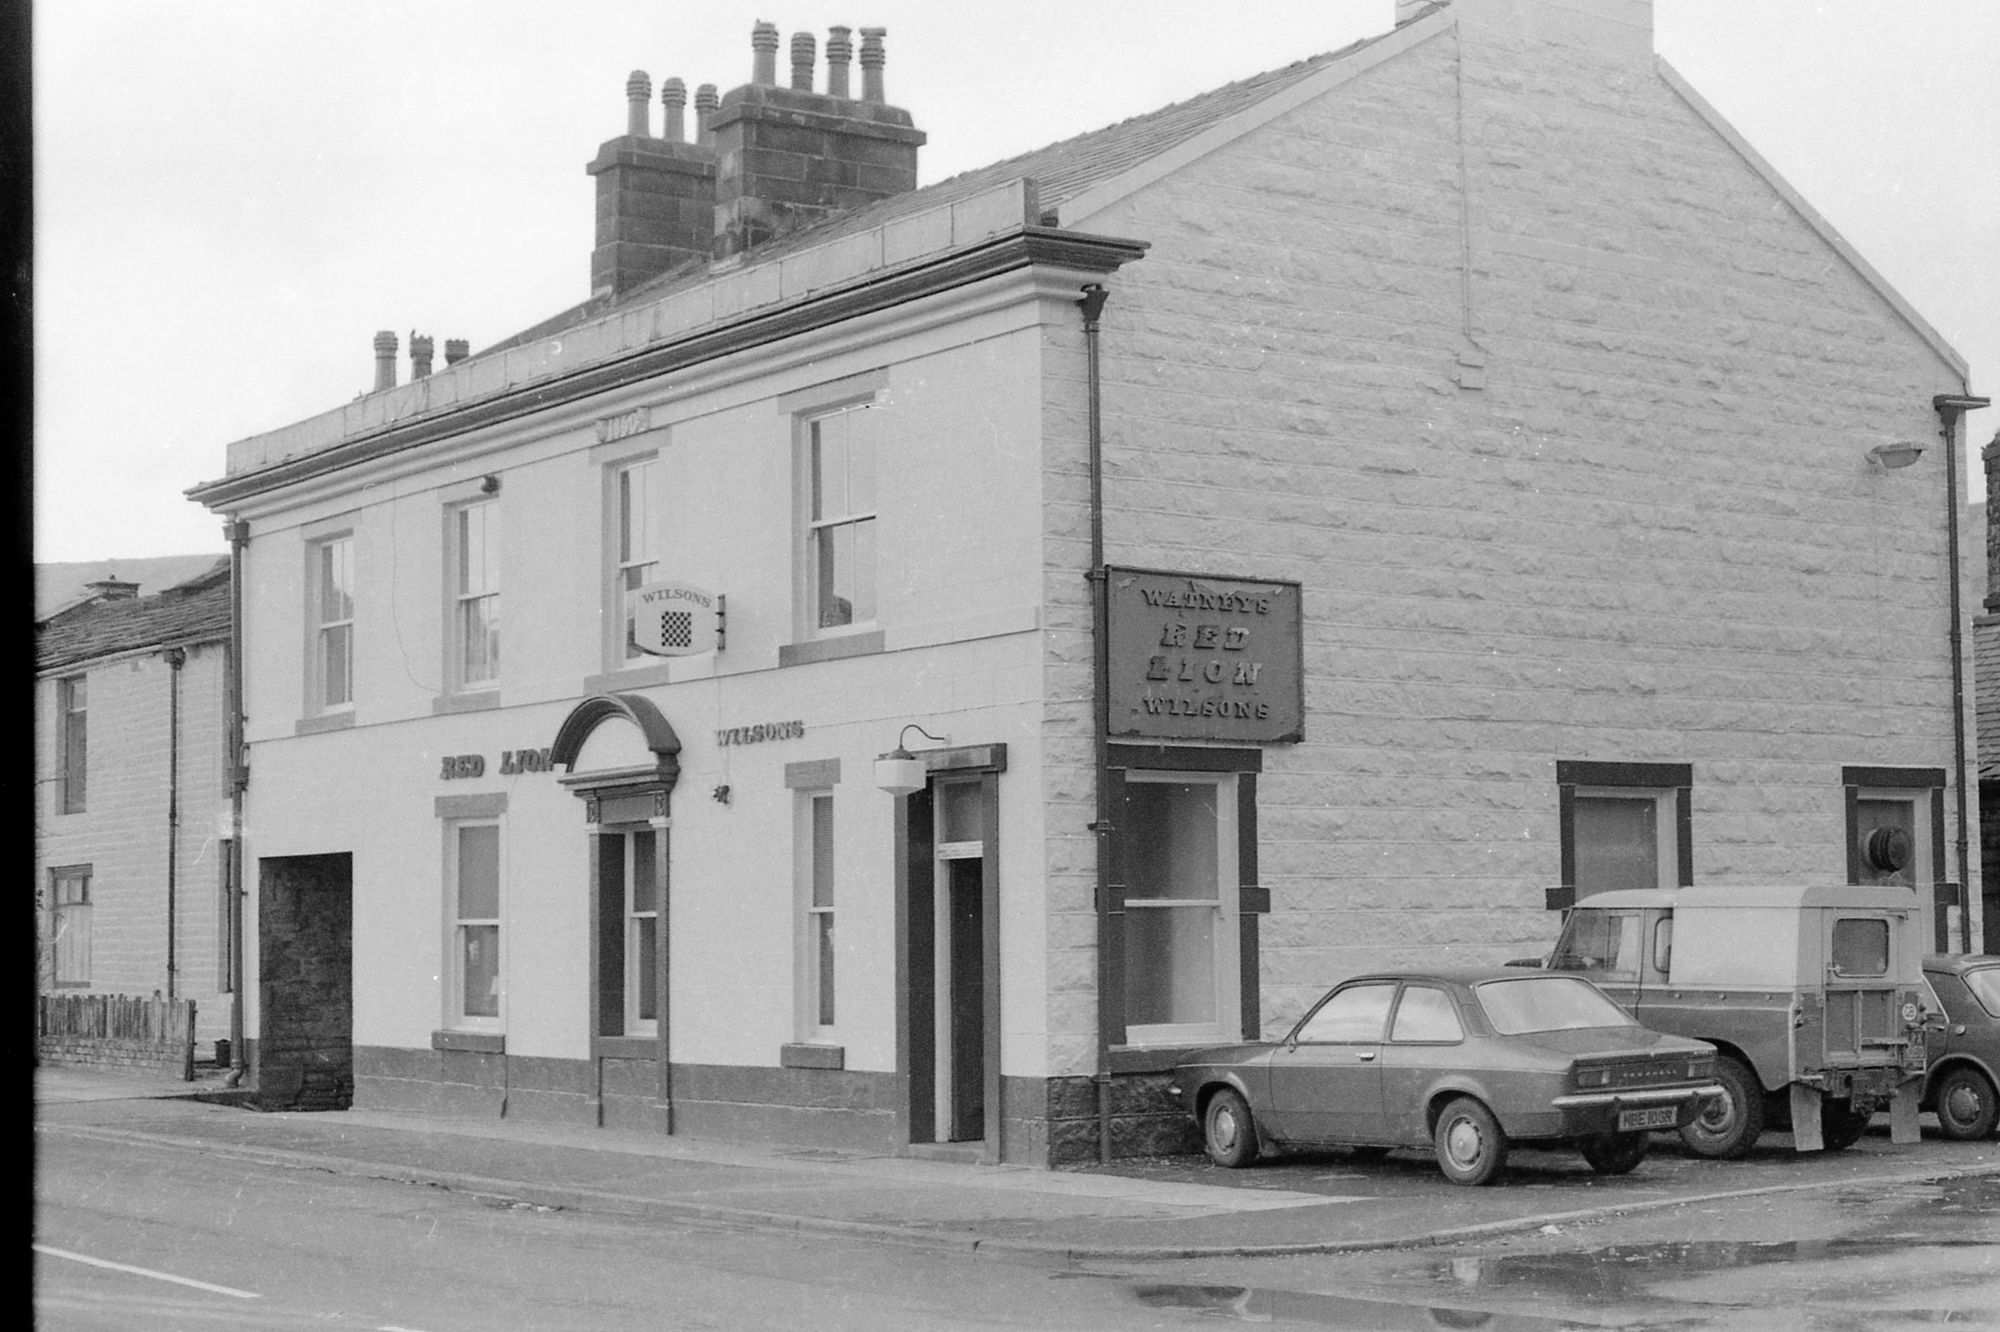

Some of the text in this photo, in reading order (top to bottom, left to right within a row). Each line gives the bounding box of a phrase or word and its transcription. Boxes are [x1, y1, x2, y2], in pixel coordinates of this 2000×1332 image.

[642, 588, 712, 608] WILSONS
[1160, 622, 1250, 651] RED
[1147, 656, 1263, 685] LION
[1143, 696, 1270, 719] WILSONS
[714, 720, 804, 746] WILSONS
[440, 754, 485, 780] RED
